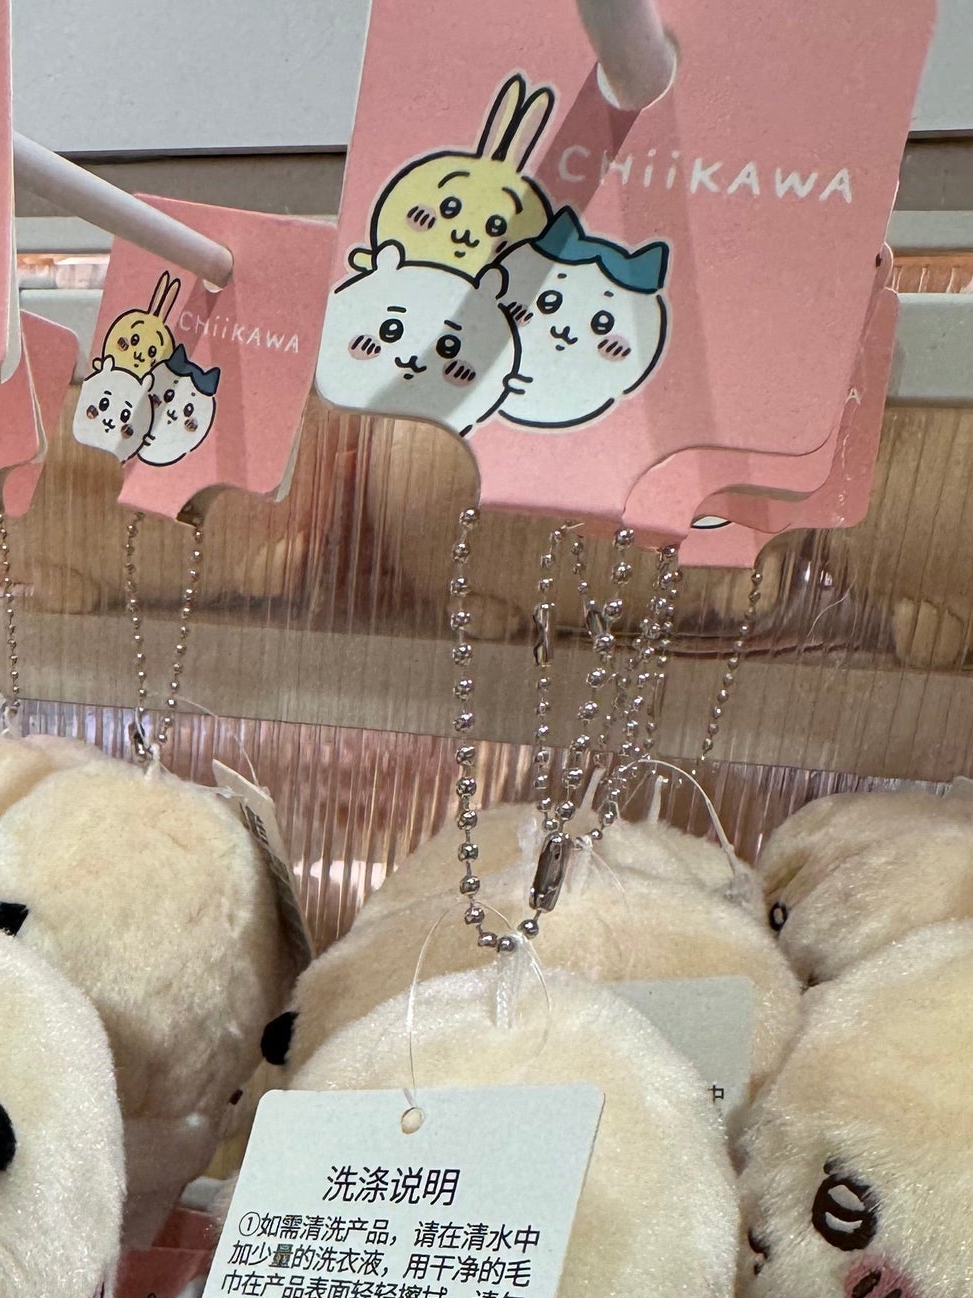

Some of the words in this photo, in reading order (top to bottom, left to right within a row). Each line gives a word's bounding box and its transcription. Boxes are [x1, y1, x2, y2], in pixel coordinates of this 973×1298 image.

[322, 1165, 461, 1207] 洗涤说明
[227, 1239, 532, 1288] 加少量的洗衣液，用干净的毛
